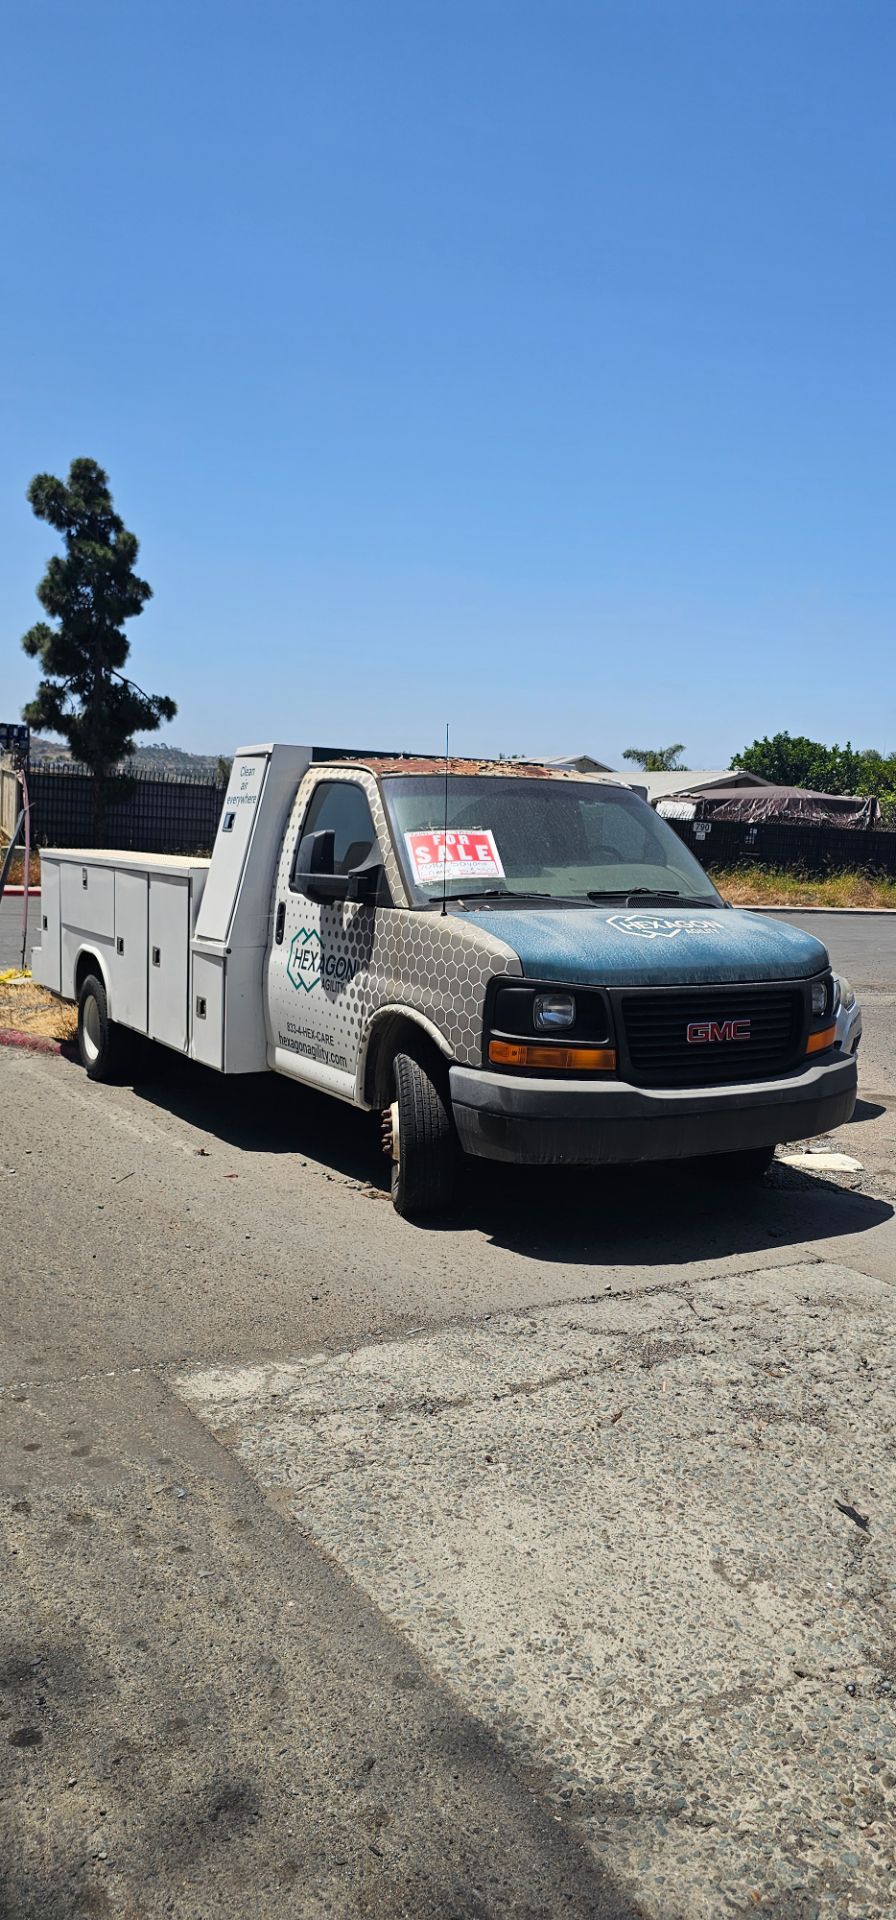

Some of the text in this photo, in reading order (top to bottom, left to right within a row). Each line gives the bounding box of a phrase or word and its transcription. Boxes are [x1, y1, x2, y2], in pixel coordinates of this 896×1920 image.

[695, 822, 710, 832] 790
[432, 834, 470, 846] FOR
[415, 844, 493, 863] SALE
[620, 921, 724, 929] HEXAGON
[293, 947, 357, 983] HEXAGON
[321, 978, 346, 994] AGILITY
[687, 1019, 751, 1043] GMC
[278, 1031, 348, 1068] hexagonagility.com
